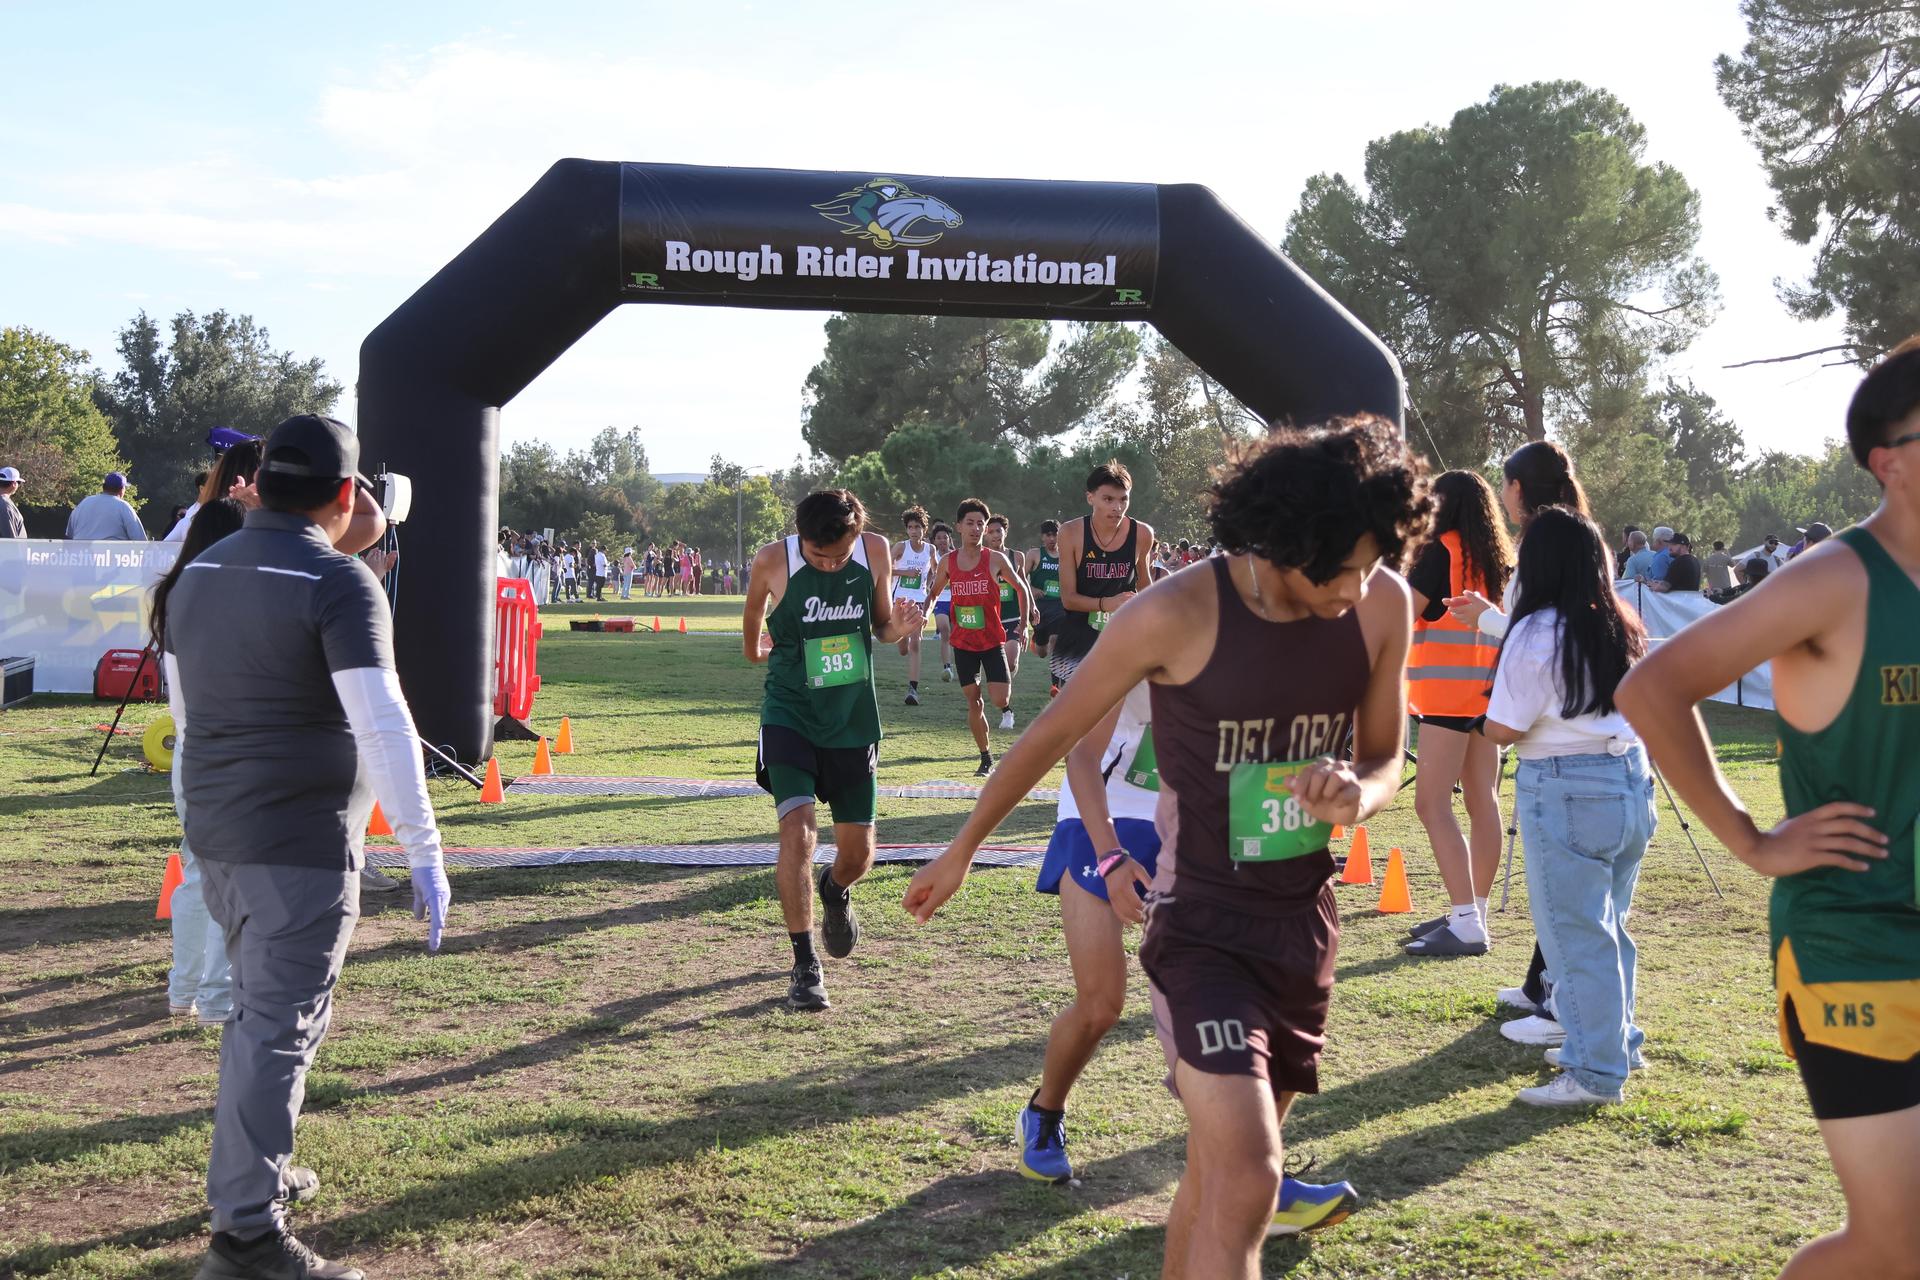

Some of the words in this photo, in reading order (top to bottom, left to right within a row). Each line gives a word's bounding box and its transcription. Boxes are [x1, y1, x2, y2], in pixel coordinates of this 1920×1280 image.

[665, 240, 783, 281] Rough
[796, 246, 894, 279] Rider
[906, 249, 1117, 286] Invitational
[951, 580, 989, 596] TRIBE
[802, 595, 865, 623] Dinuba
[961, 614, 977, 624] 281
[1095, 610, 1115, 623] 19
[821, 652, 854, 674] 393
[1823, 1001, 1876, 1028] KHS
[1195, 1019, 1247, 1056] DO
